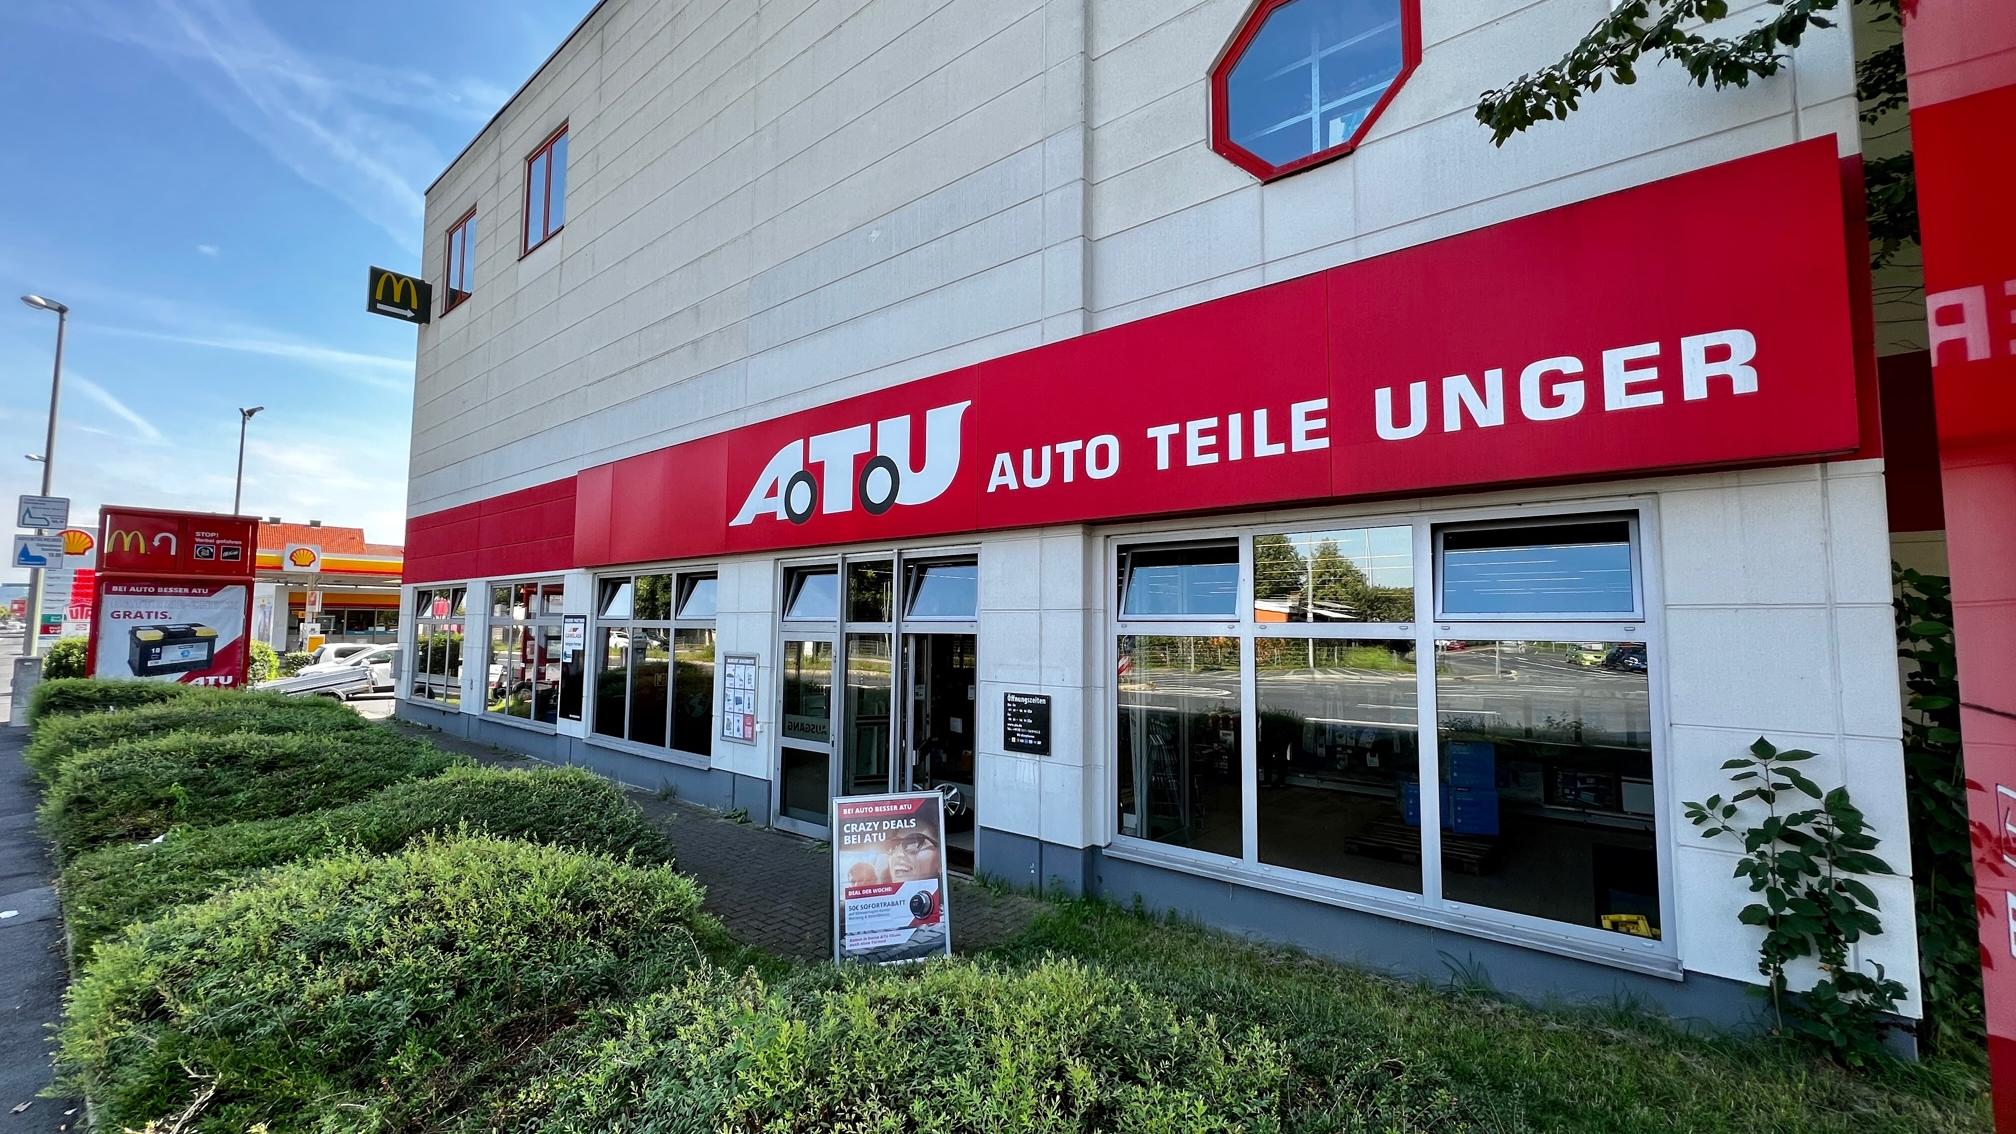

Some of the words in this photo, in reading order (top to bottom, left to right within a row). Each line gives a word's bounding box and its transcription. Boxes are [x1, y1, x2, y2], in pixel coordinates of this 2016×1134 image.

[987, 434, 1120, 492] AUTO
[1146, 397, 1330, 470] TEILE
[1374, 328, 1759, 441] UNGER
[729, 400, 971, 525] ATU
[111, 585, 127, 593] BEI
[110, 610, 172, 620] GRATIS.
[855, 806, 874, 814] AUTO
[875, 804, 898, 812] BESSER
[899, 803, 912, 811] ATU
[843, 821, 880, 833] CRAZY
[882, 818, 917, 830] DEALS
[843, 834, 861, 845] BEI
[863, 832, 886, 844] ATU
[860, 899, 906, 911] SOFORTRABATT
